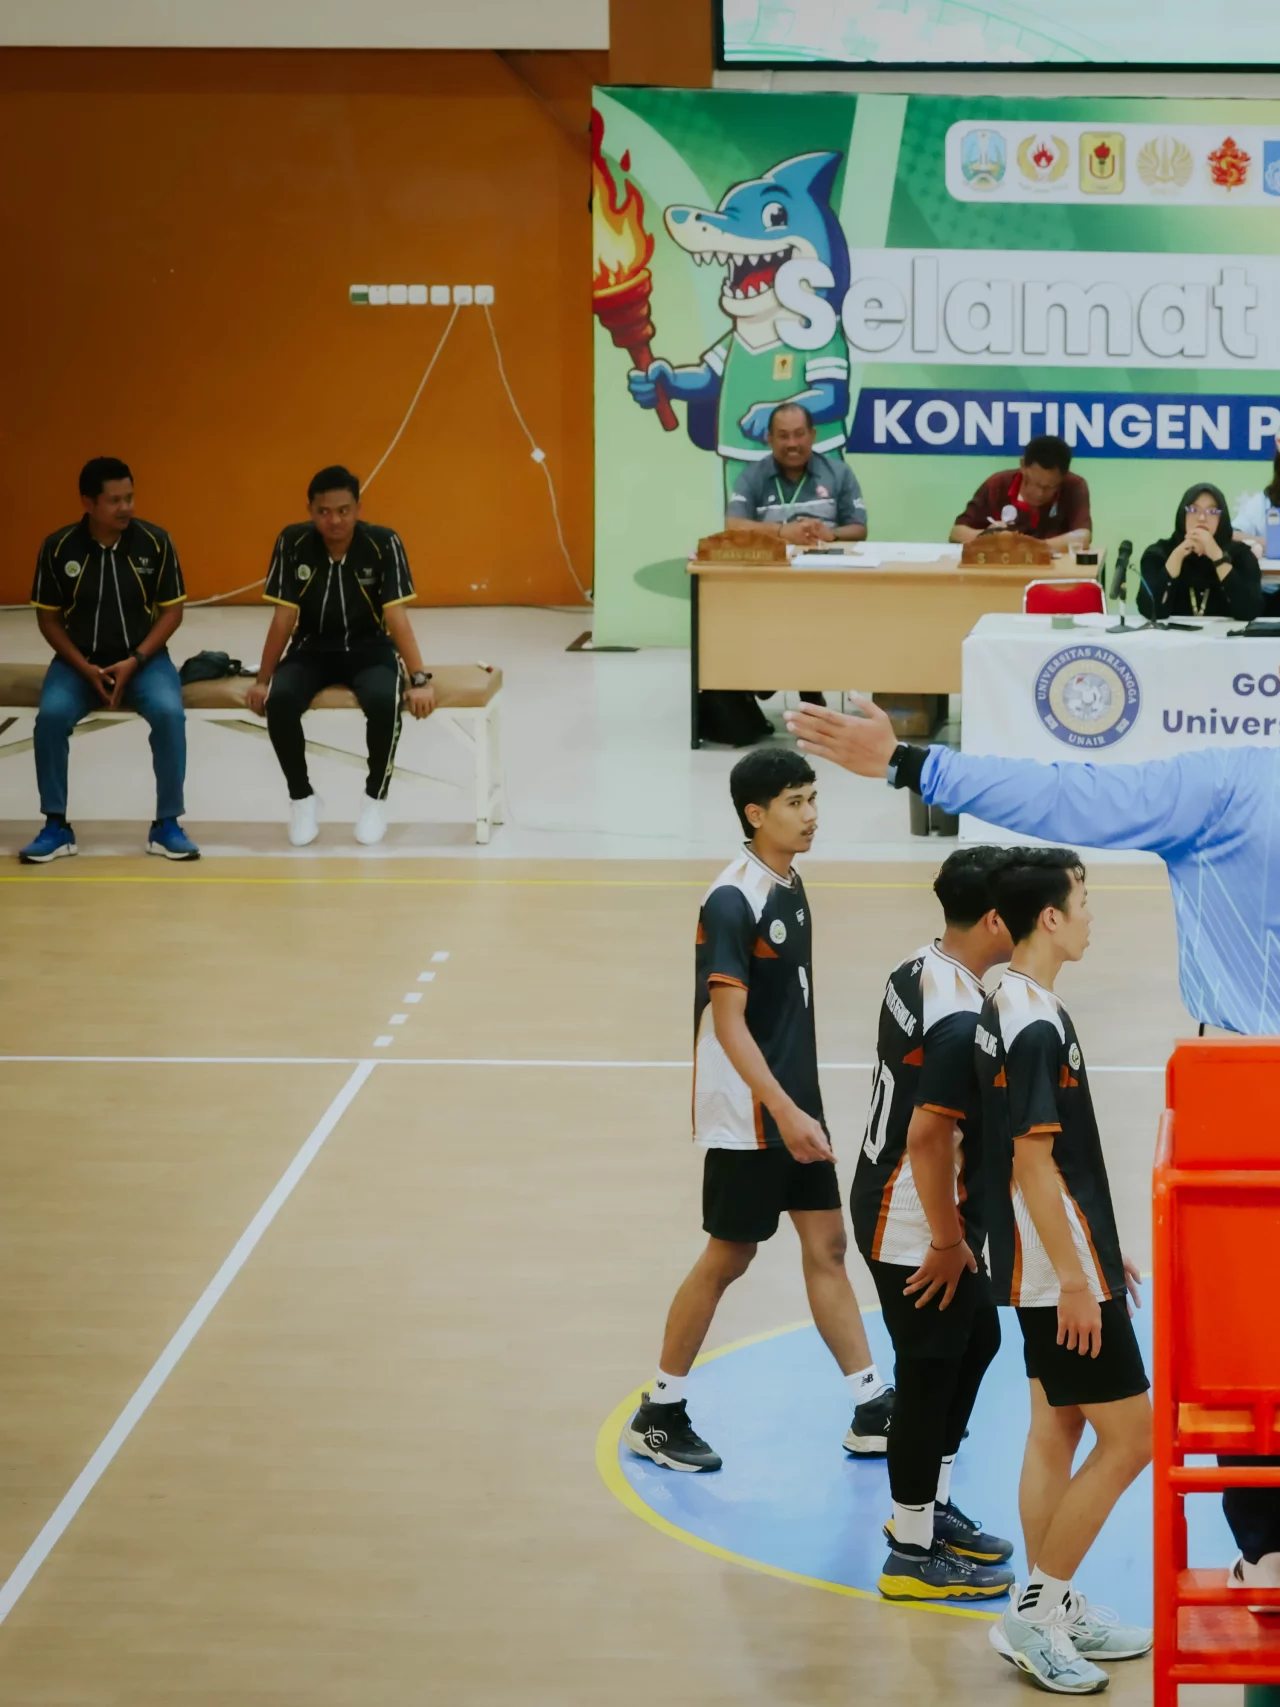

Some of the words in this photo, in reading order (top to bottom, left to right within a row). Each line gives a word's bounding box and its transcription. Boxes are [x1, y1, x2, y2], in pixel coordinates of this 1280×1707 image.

[772, 255, 1259, 359] Selamat
[873, 398, 1232, 451] KONTINGEN
[1037, 647, 1092, 701] UNIVERSITAS
[1094, 649, 1137, 705] AIRLANGGA
[1068, 732, 1106, 747] UNAIR
